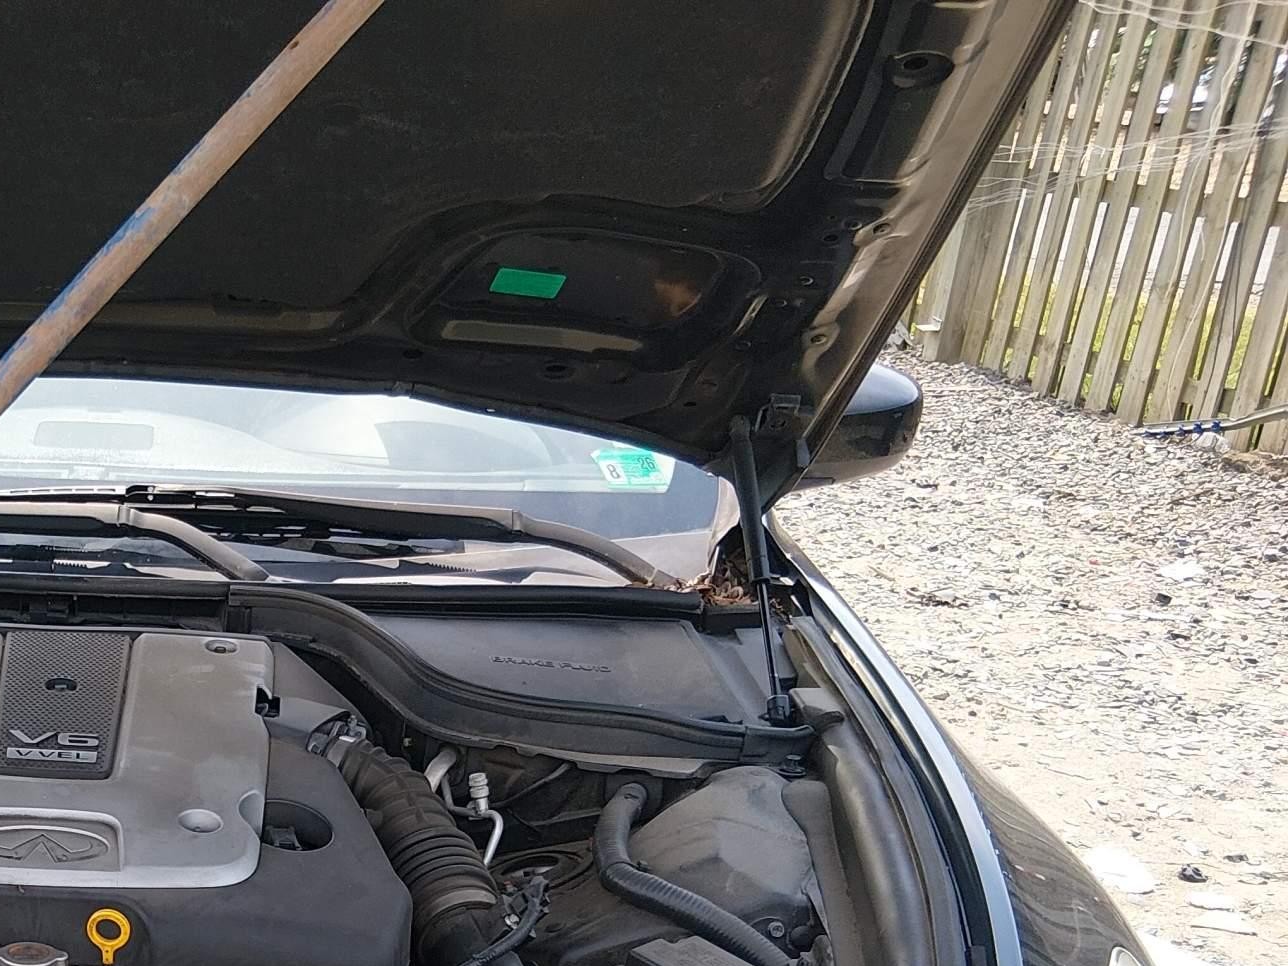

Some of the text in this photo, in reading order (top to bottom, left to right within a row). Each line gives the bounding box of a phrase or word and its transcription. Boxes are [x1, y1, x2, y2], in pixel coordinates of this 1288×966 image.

[606, 463, 621, 480] 8
[637, 456, 657, 472] 26
[489, 655, 556, 669] BRAKE
[9, 729, 100, 747] V6
